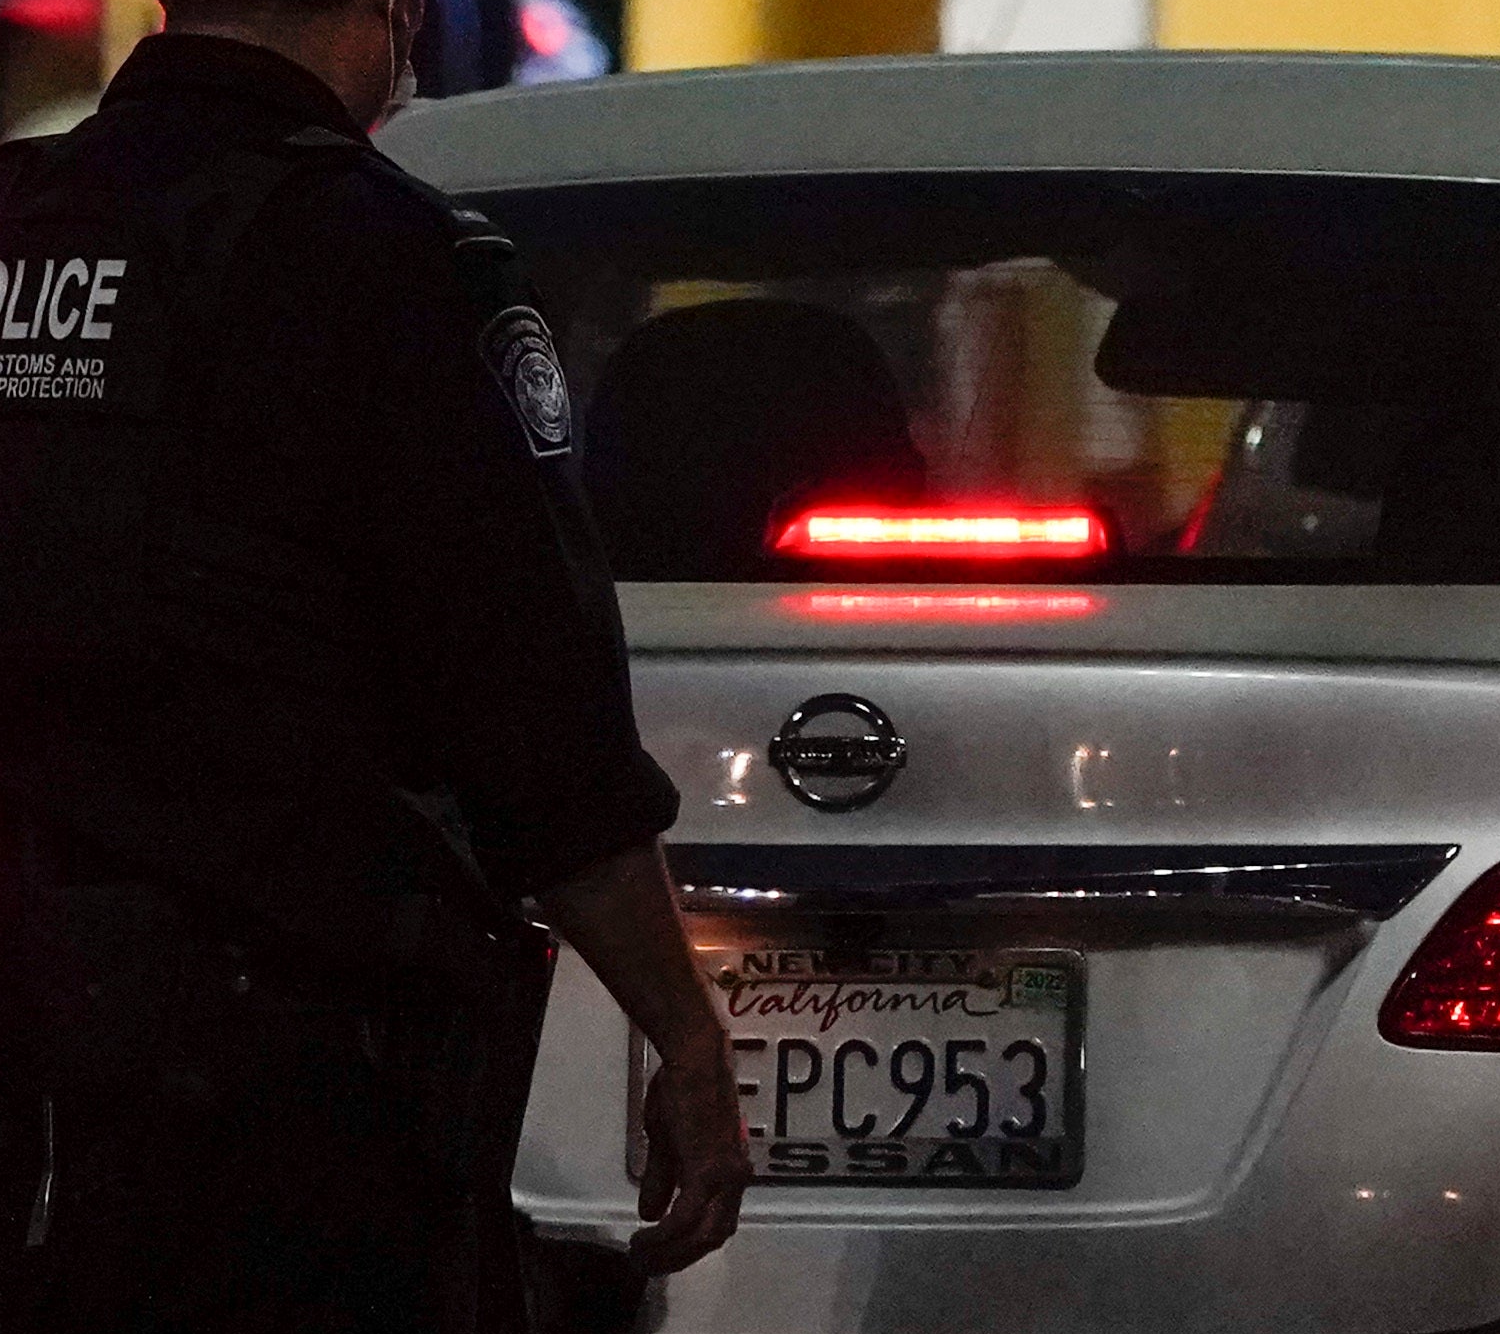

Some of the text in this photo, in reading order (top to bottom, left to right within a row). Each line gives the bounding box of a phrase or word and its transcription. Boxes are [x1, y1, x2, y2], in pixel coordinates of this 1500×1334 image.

[60, 357, 105, 377] AND
[727, 979, 1000, 1032] California
[731, 1037, 1049, 1139] EPC953
[766, 1141, 1064, 1175] SSAN
